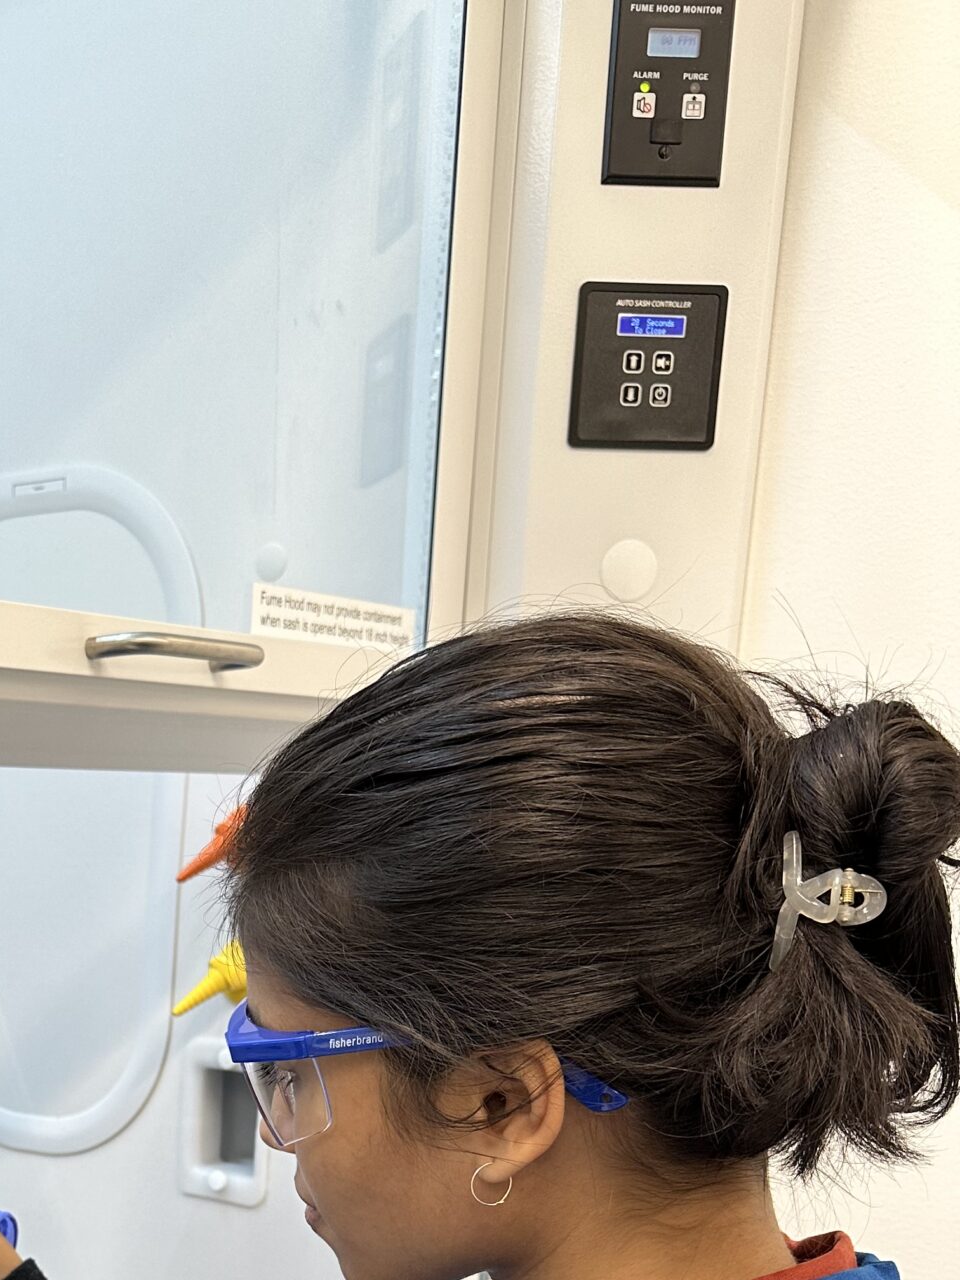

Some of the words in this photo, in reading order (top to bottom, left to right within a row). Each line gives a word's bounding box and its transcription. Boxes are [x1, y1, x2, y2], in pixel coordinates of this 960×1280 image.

[630, 3, 654, 13] FUME
[656, 4, 681, 13] HOOD
[683, 5, 723, 15] MONITOR
[633, 71, 660, 79] ALARM
[683, 72, 709, 81] PURGE
[616, 299, 634, 307] AUTO
[635, 299, 651, 307] SASH
[651, 300, 692, 308] CONTROLLER
[646, 318, 675, 328] Seconds
[260, 590, 282, 608] Fume
[284, 595, 305, 612] Hood
[306, 601, 321, 618] may
[323, 604, 335, 615] not
[336, 606, 361, 621] provide
[260, 613, 281, 628] when
[283, 617, 300, 632] sash
[302, 621, 308, 633] is
[310, 623, 337, 637] opened
[337, 624, 363, 642] beyond
